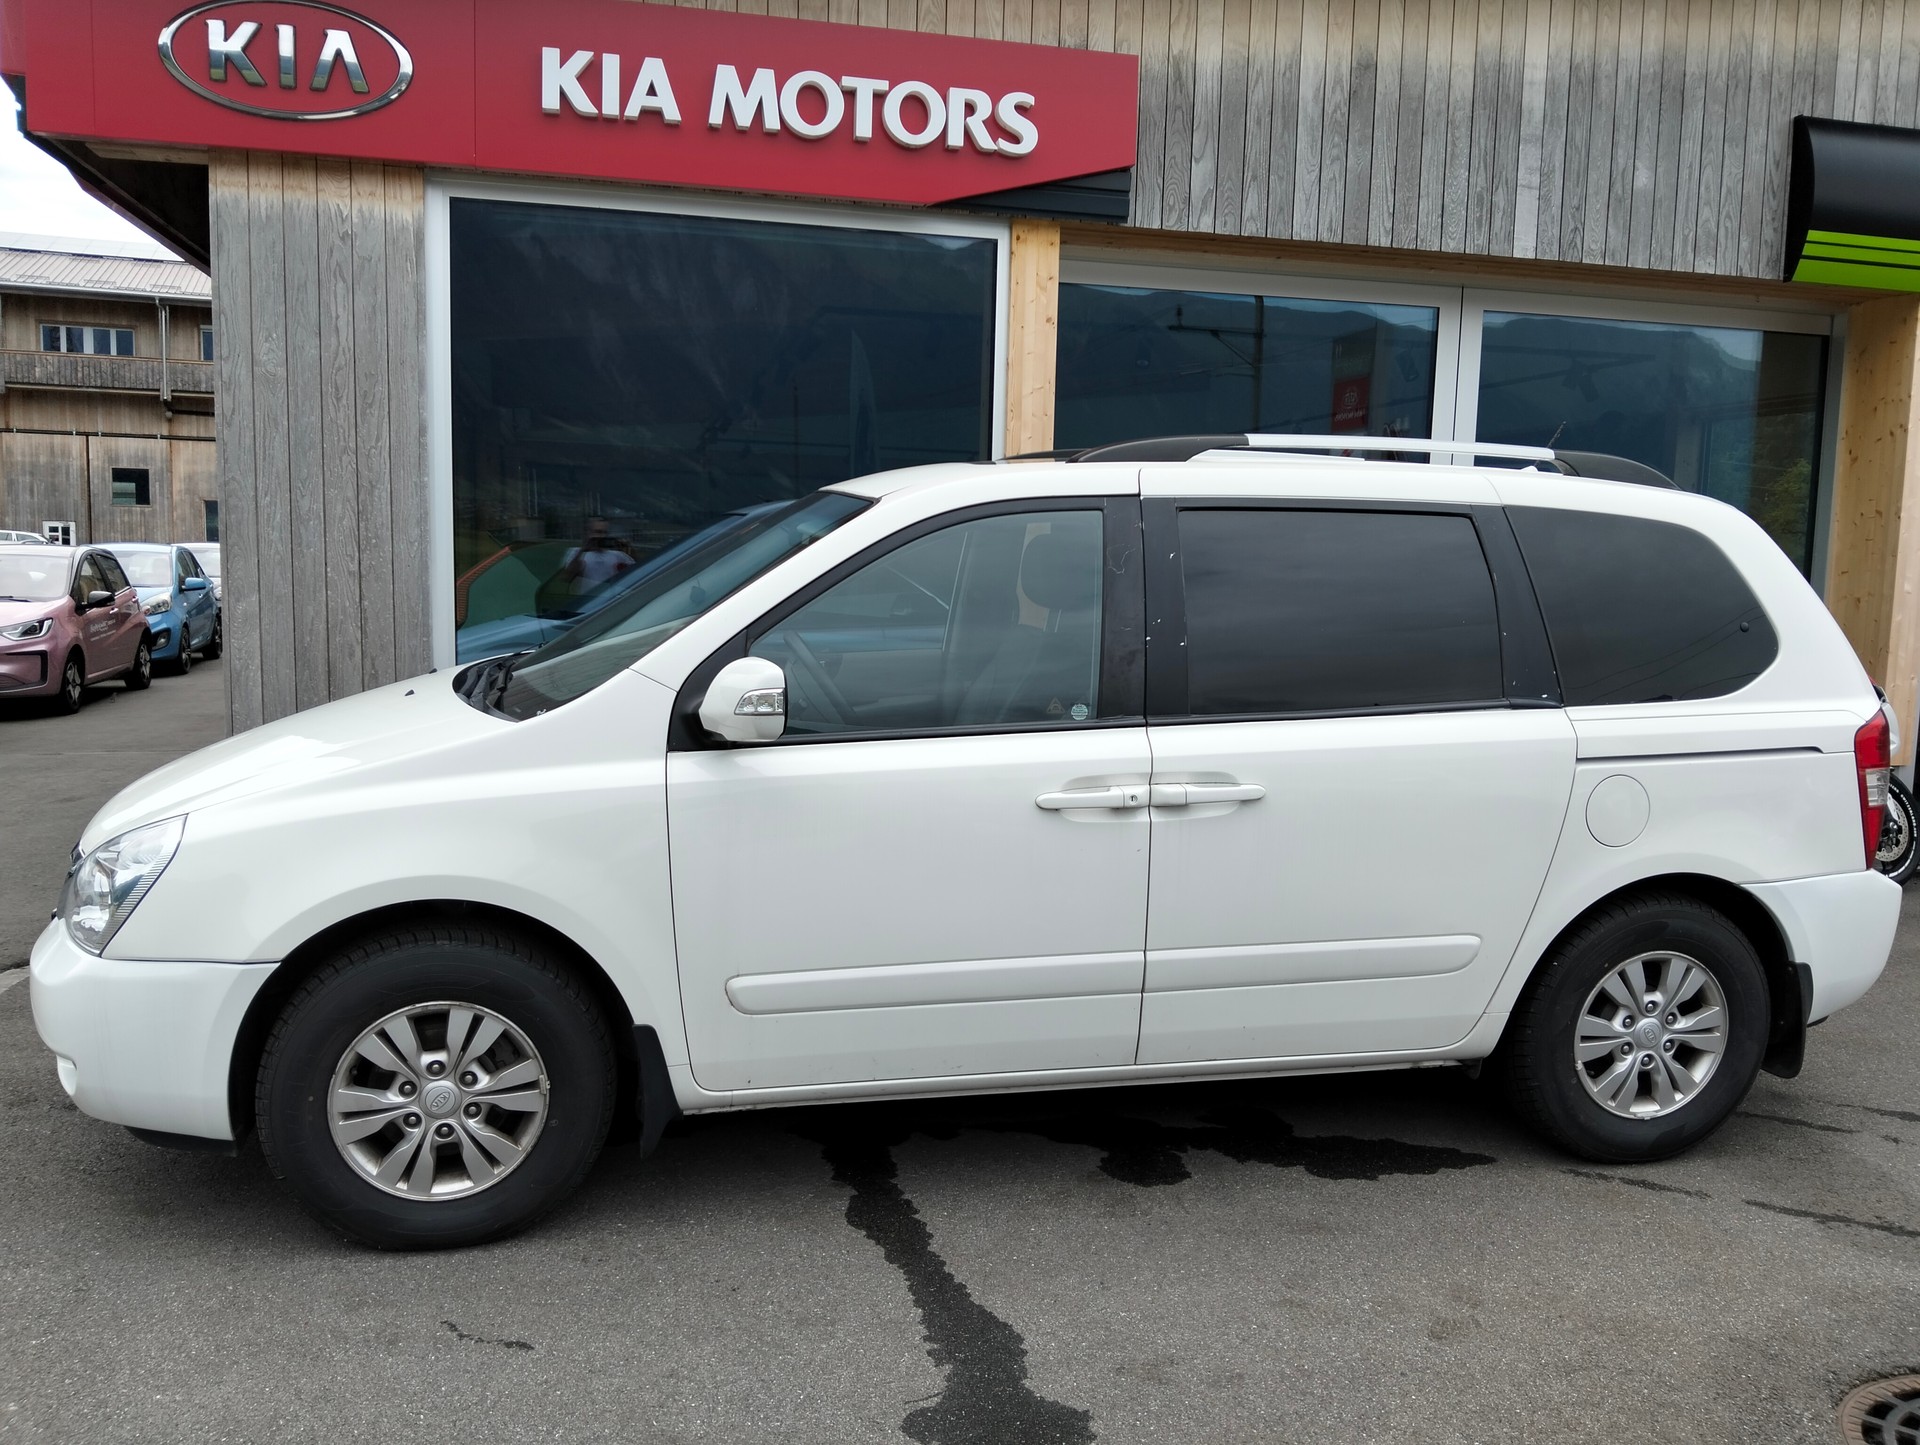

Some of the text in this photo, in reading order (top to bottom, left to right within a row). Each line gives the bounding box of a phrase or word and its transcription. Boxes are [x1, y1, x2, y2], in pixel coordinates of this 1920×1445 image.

[205, 19, 370, 94] KIA
[542, 46, 1039, 158] KIA MOTORS
[432, 1092, 449, 1109] KIA
